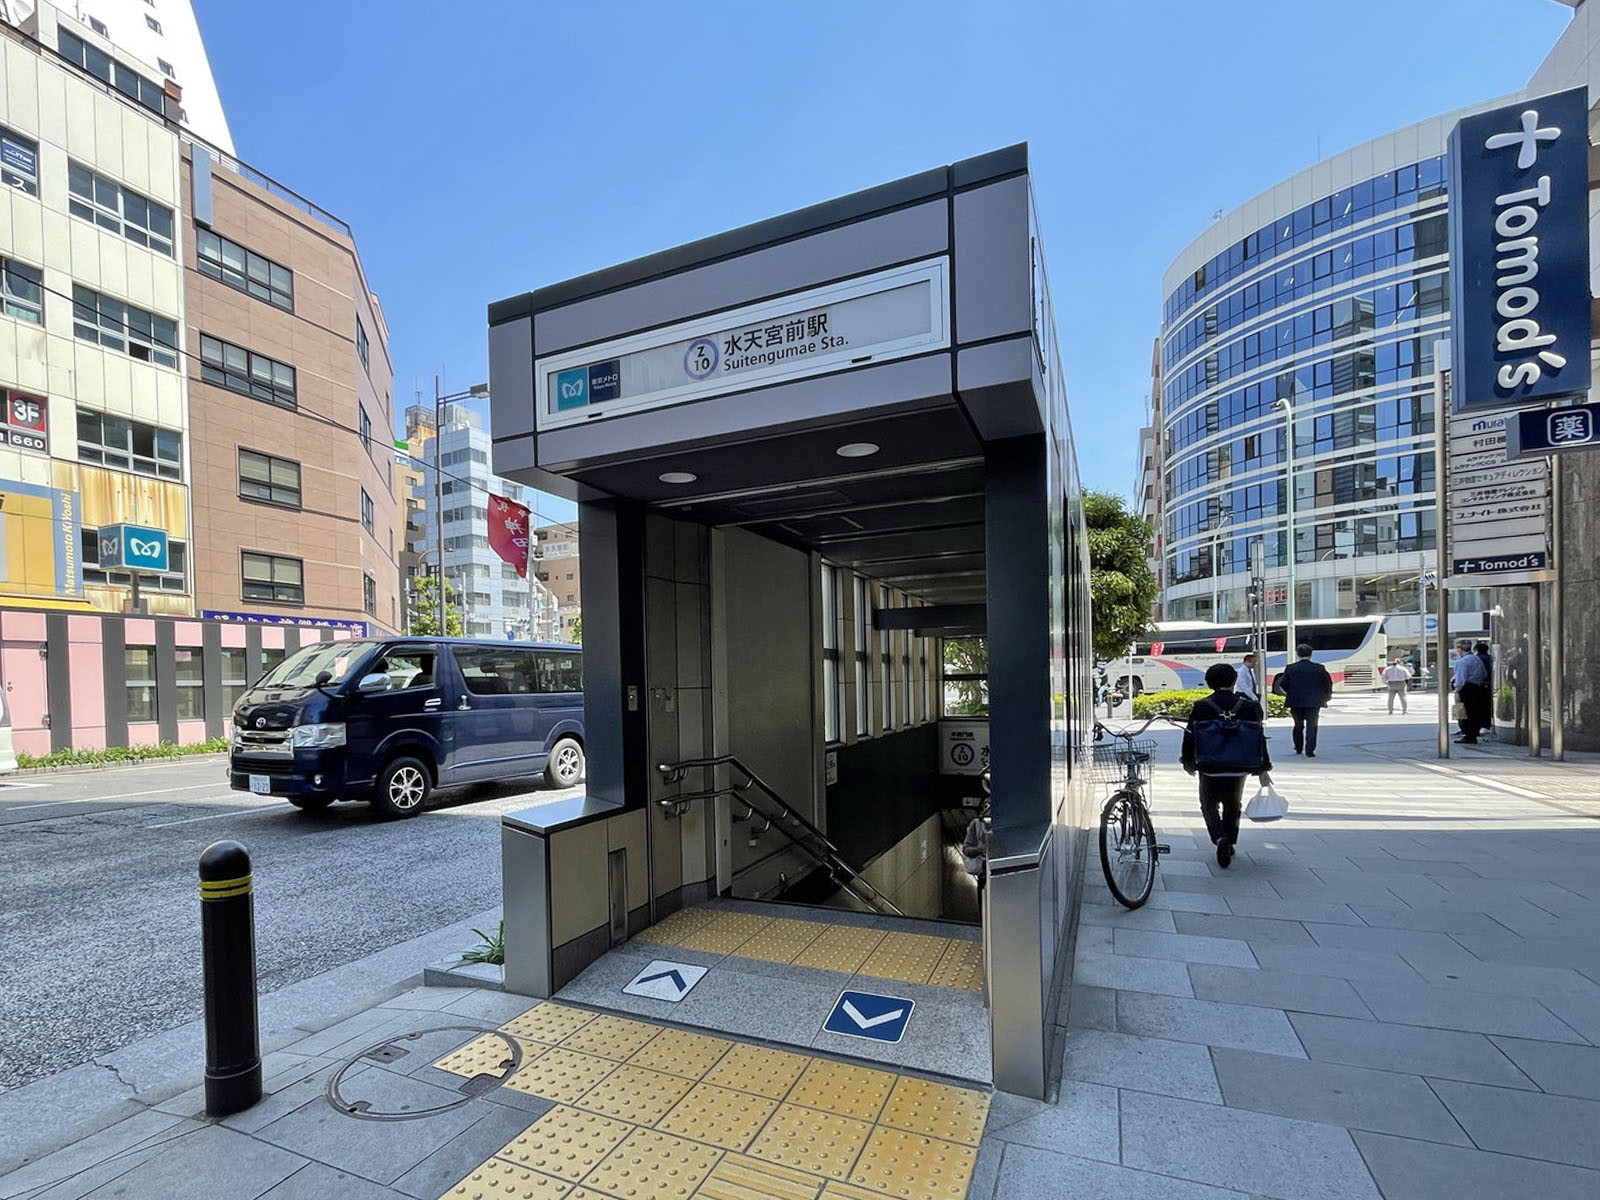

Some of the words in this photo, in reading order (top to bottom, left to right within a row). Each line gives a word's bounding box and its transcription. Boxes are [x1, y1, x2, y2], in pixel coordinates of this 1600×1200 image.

[1495, 175, 1567, 389] Tomod's
[724, 313, 828, 357] 水天宮前駅
[697, 346, 705, 358] Z
[723, 344, 816, 372] Suitengumae
[821, 335, 849, 351] Sta.
[694, 357, 710, 372] 10
[14, 399, 39, 423] 3F
[1472, 418, 1507, 431] mura
[1555, 416, 1585, 440] 薬
[12, 434, 44, 449] 660
[65, 534, 76, 596] Matsumoto
[1478, 554, 1539, 571] Tomod's
